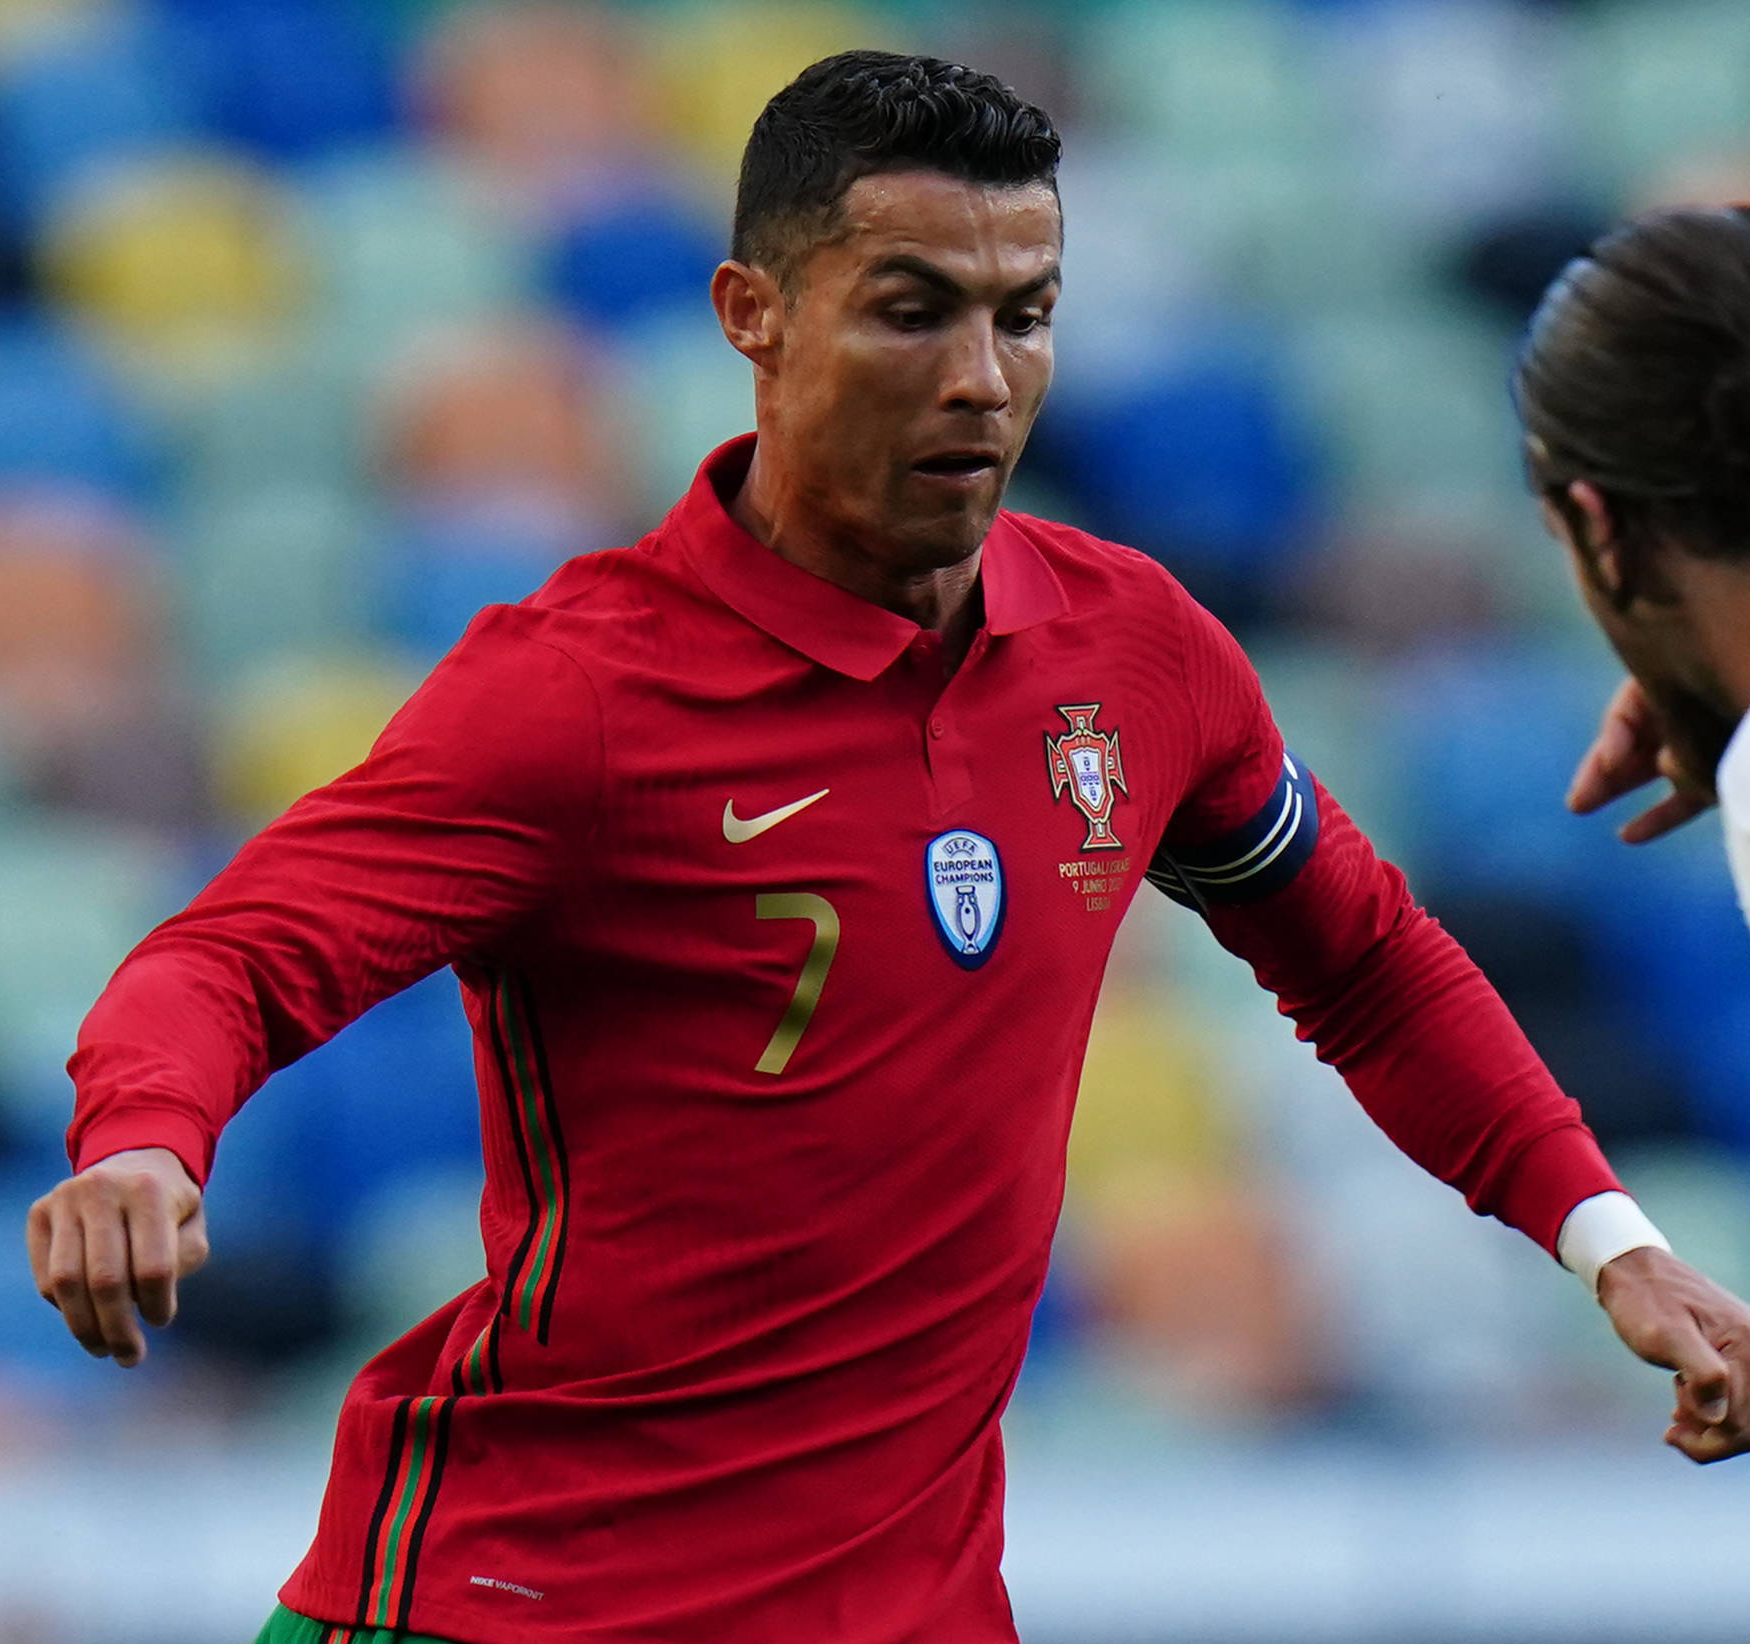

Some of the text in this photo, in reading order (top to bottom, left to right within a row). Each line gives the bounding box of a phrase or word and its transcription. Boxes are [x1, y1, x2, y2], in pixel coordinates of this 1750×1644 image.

[945, 839, 975, 854] UEFA
[934, 859, 993, 872] EUROPEAN
[935, 871, 994, 884] CHAMPIONS
[754, 893, 840, 1075] 7
[470, 1575, 494, 1587] NIKE
